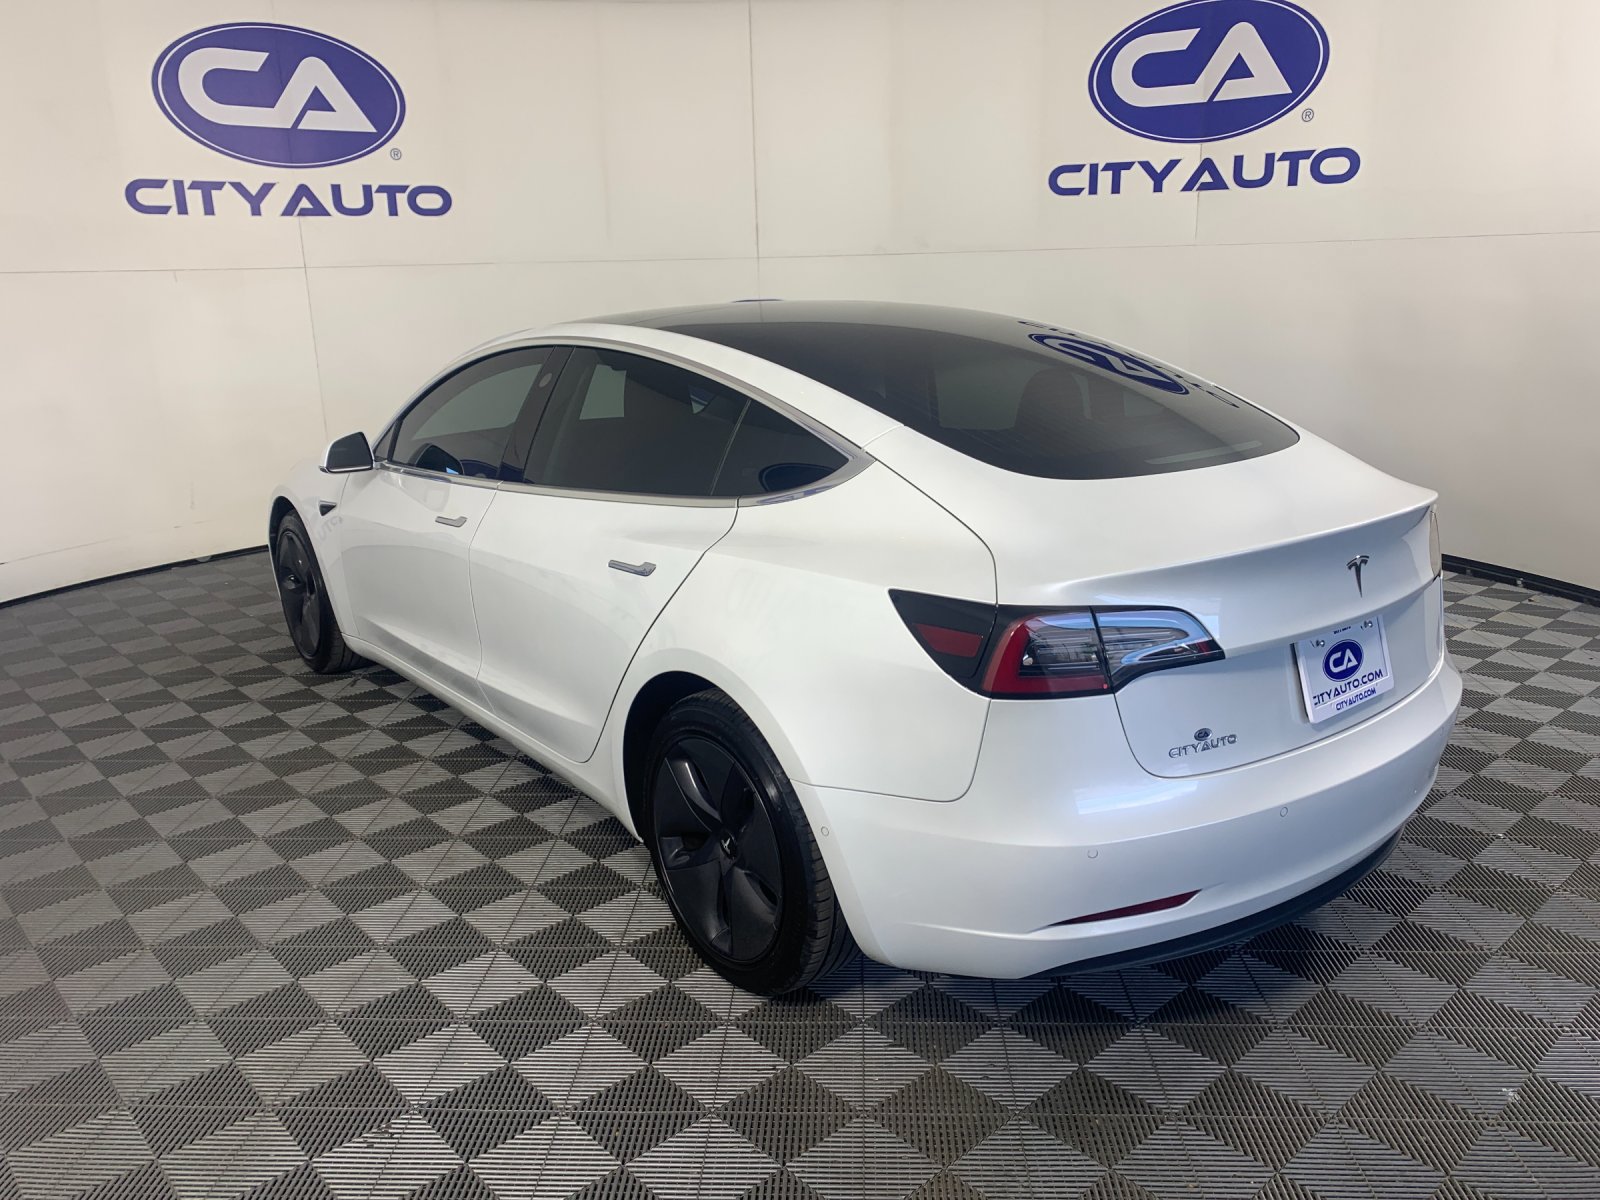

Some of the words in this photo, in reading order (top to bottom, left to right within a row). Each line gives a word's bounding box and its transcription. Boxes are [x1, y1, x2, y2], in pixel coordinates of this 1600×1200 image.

[1111, 21, 1293, 108] CA
[177, 47, 378, 133] CA
[1329, 648, 1359, 673] CA
[1312, 668, 1384, 706] CITYAUTO.COM
[1335, 687, 1377, 711] CITYAUTO.COM
